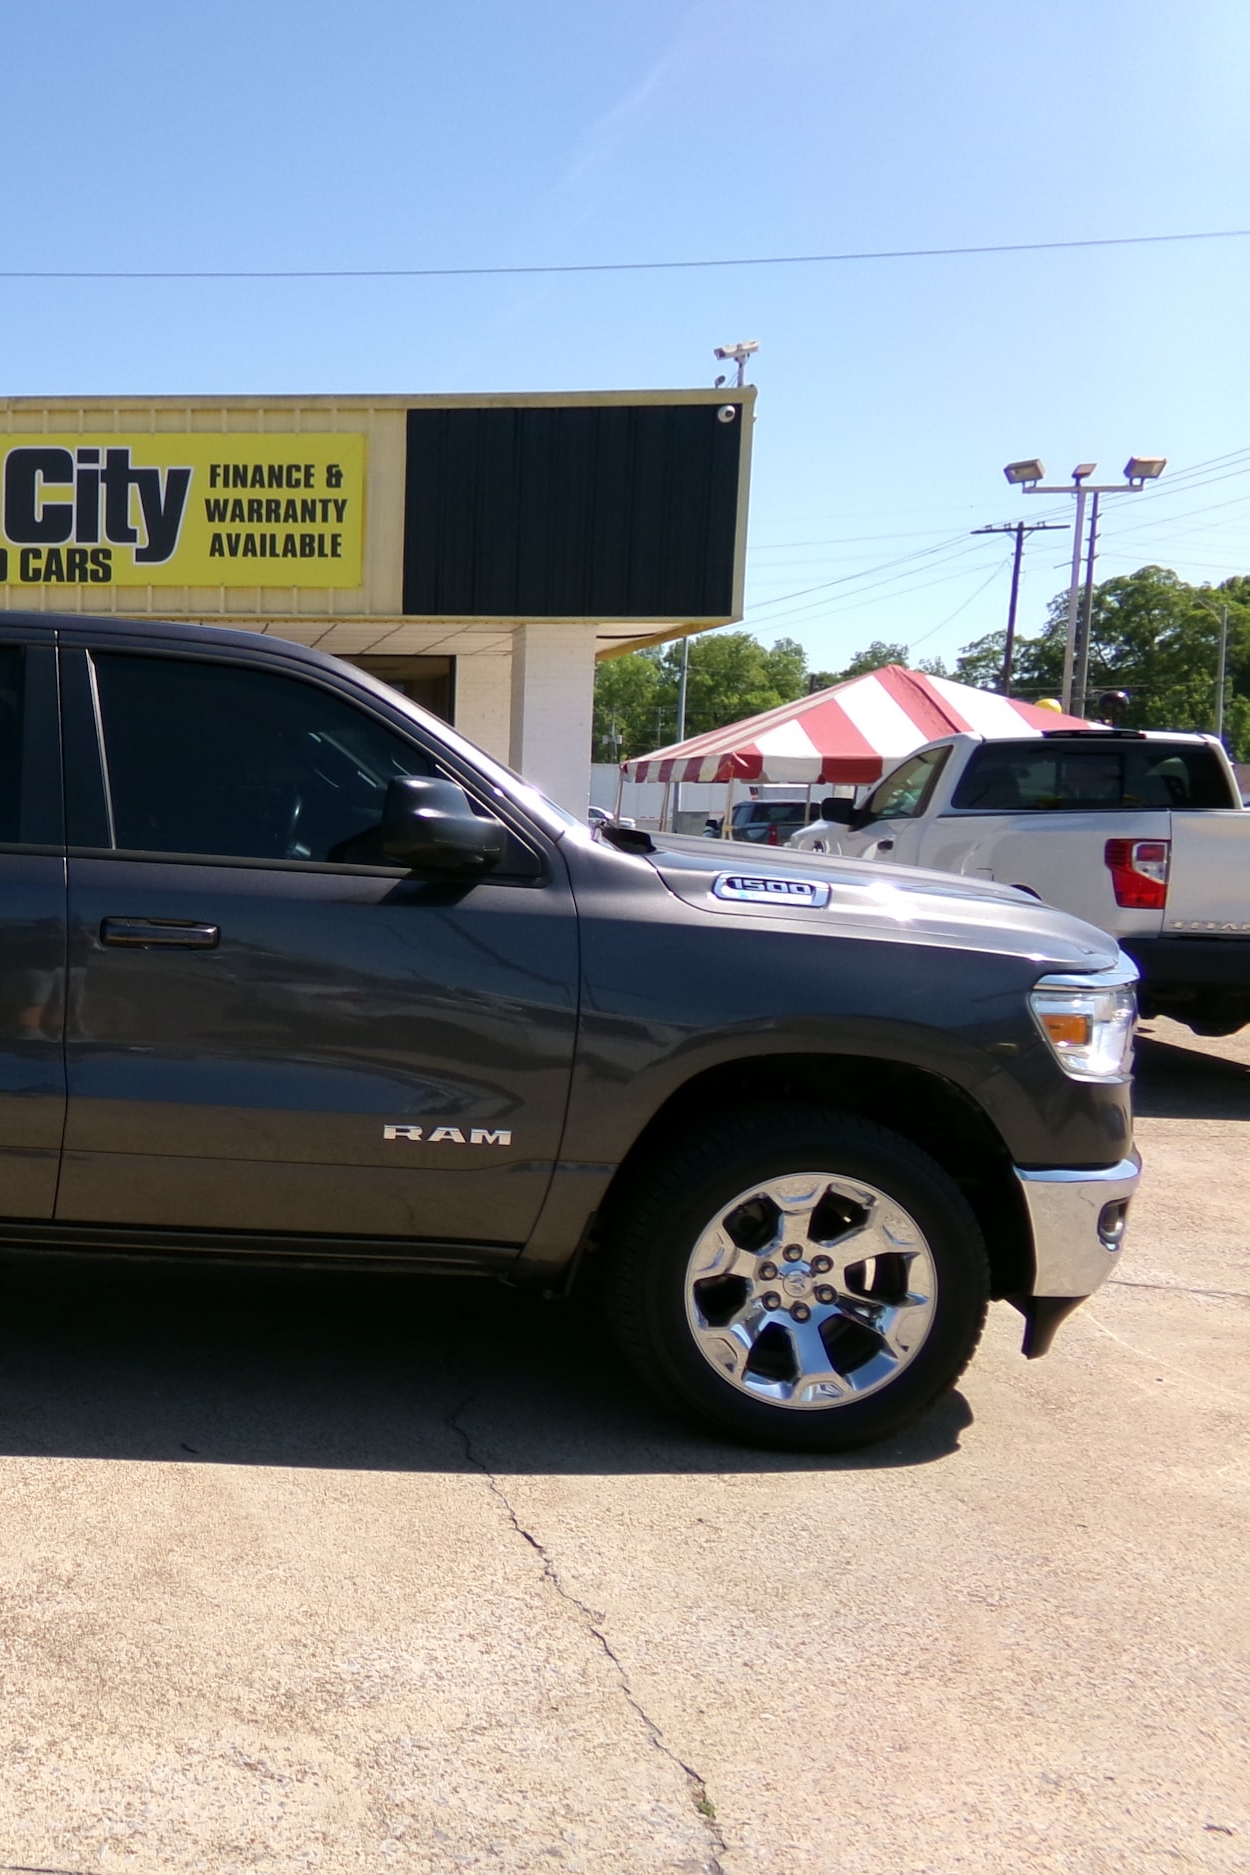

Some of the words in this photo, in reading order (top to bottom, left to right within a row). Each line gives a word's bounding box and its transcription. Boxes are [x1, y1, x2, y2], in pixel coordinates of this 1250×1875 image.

[209, 464, 315, 488] FINANCE
[326, 464, 343, 488] &
[205, 498, 347, 523] WARRANTY
[209, 533, 342, 558] AVAILABLE
[19, 548, 112, 583] CARS
[730, 878, 812, 896] 1500
[383, 1124, 512, 1146] RAM
